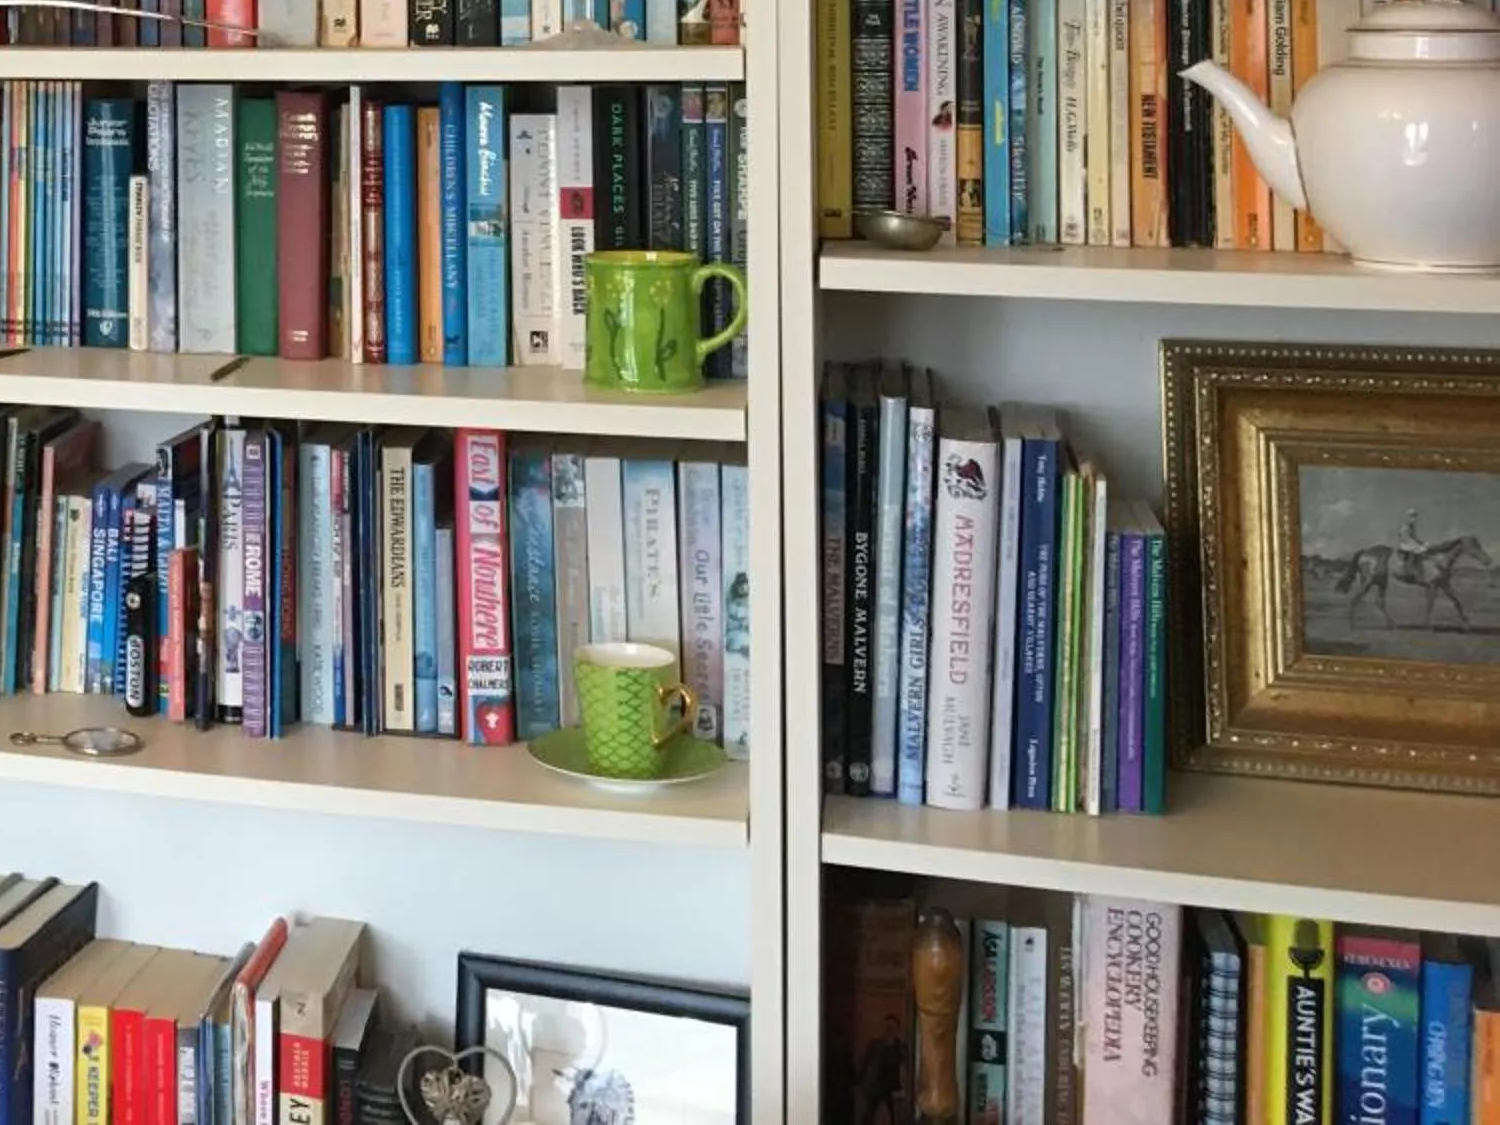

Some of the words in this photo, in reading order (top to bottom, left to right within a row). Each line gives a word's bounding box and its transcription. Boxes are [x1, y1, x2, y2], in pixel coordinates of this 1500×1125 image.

[903, 30, 920, 92] WOMEN
[936, 12, 950, 96] AWAKENING
[1010, 5, 1024, 65] ALMOND
[1272, 26, 1288, 76] Golding
[214, 98, 229, 195] MARIAN
[611, 103, 623, 147] DARK
[611, 153, 624, 215] PLACES
[570, 225, 587, 253] LOOK
[571, 288, 587, 316] BACK
[390, 466, 406, 495] THE
[470, 440, 497, 487] East
[222, 491, 241, 551] PARIS
[389, 497, 405, 589] EDWARDIANS
[474, 505, 501, 527] of
[107, 528, 119, 562] BALI
[245, 544, 262, 598] ROME
[695, 548, 712, 585] Our
[825, 536, 842, 568] THE
[854, 531, 869, 598] BYGONE
[1128, 538, 1143, 556] The
[1149, 538, 1164, 557] The
[89, 528, 106, 625] SINGAPORE
[473, 547, 504, 649] Nowhere
[881, 586, 897, 604] of
[948, 514, 975, 686] MADRESFIELD
[1127, 557, 1142, 598] Malvern
[1148, 558, 1164, 599] Malvern
[693, 591, 715, 630] Little
[824, 571, 842, 662] MALVERNS
[1127, 599, 1141, 621] Hills
[1148, 600, 1162, 623] Hills
[129, 637, 141, 701] BOSTON
[853, 608, 868, 694] MALVERN
[877, 616, 896, 698] Malvern
[905, 674, 924, 761] MALVERN
[957, 713, 973, 748] JANE
[1123, 909, 1143, 1012] COOKERY
[1144, 911, 1163, 964] GOOD
[1102, 907, 1125, 1066] ENCYCLOPEDIA
[1141, 965, 1162, 1079] HOUSEKEEPING
[1294, 986, 1316, 1086] AUNTIE'S
